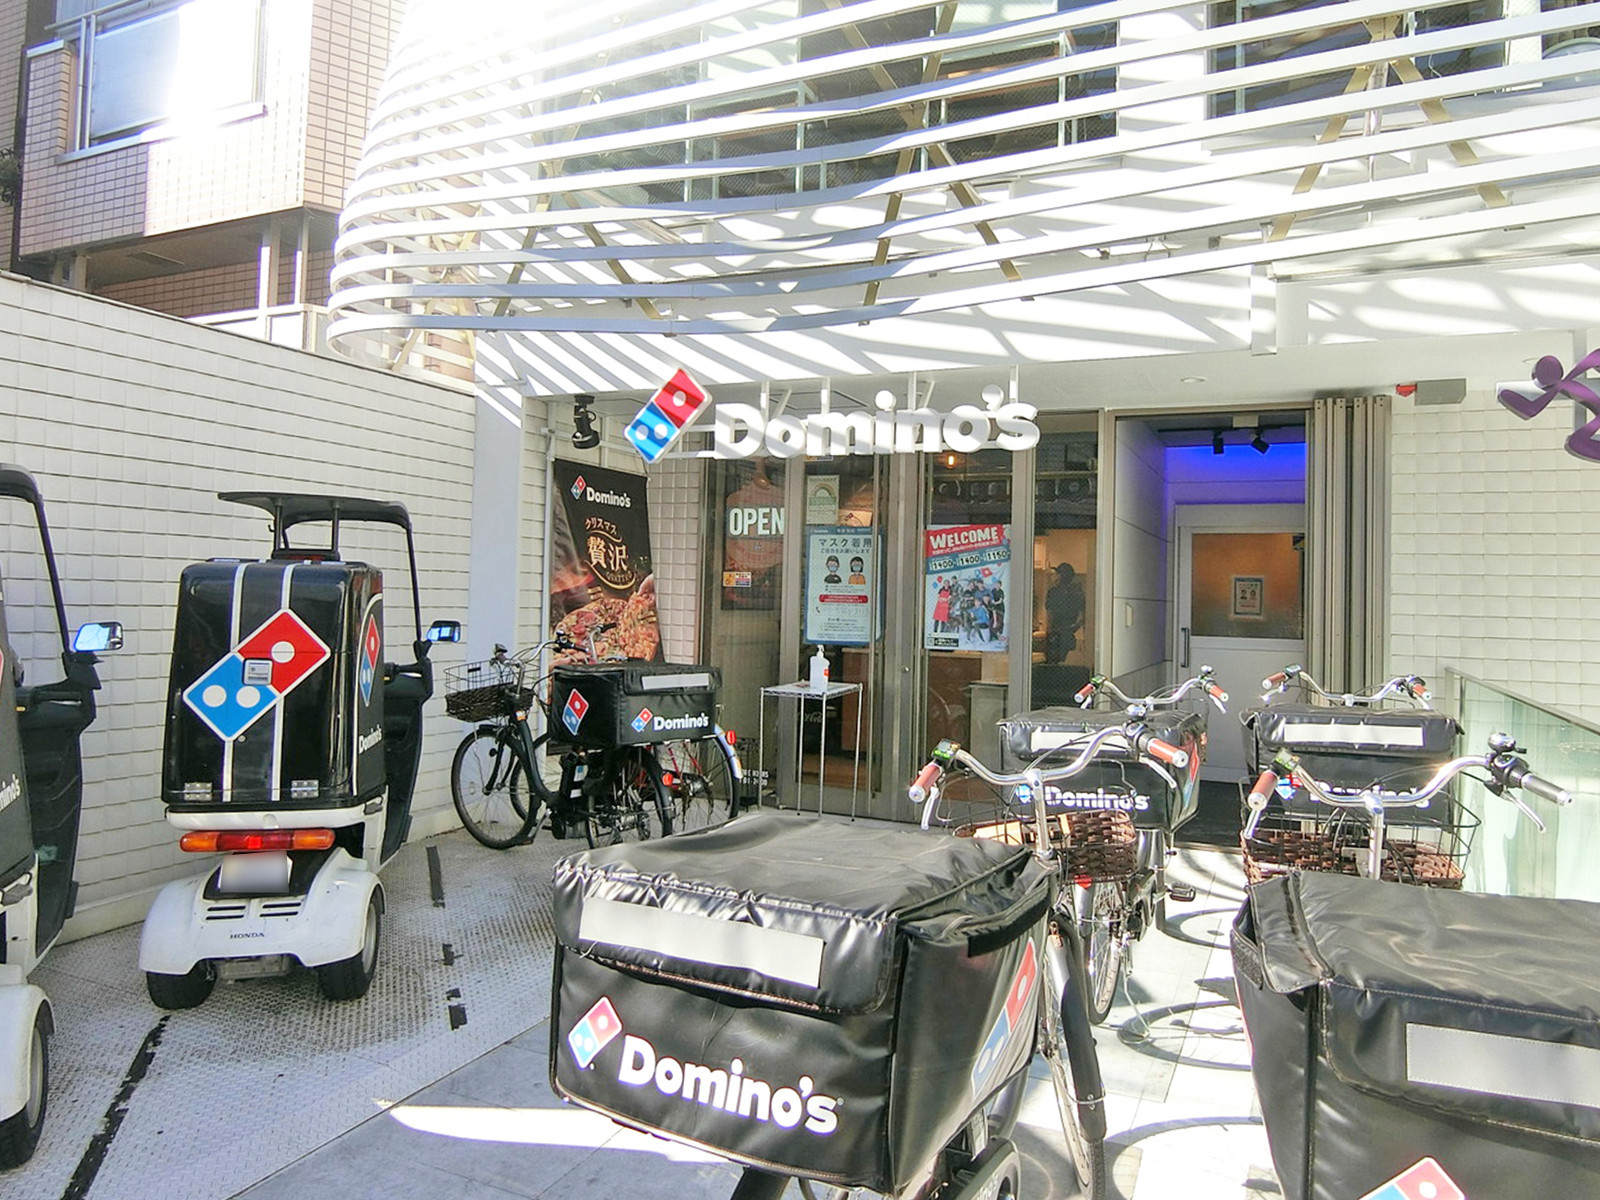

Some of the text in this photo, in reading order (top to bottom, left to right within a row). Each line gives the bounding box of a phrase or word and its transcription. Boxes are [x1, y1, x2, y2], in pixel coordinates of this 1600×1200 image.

[714, 383, 1041, 459] Domino's
[586, 486, 632, 508] Domino's
[584, 517, 618, 536] クリスマス
[729, 507, 785, 536] OPEN
[818, 538, 873, 548] マスク着用
[929, 527, 999, 550] WELCOME
[586, 536, 629, 571] 贅沢
[654, 713, 709, 731] Domino's
[358, 724, 382, 754] Domino's
[1044, 785, 1149, 810] Domino's
[618, 1034, 839, 1135] Domino's
